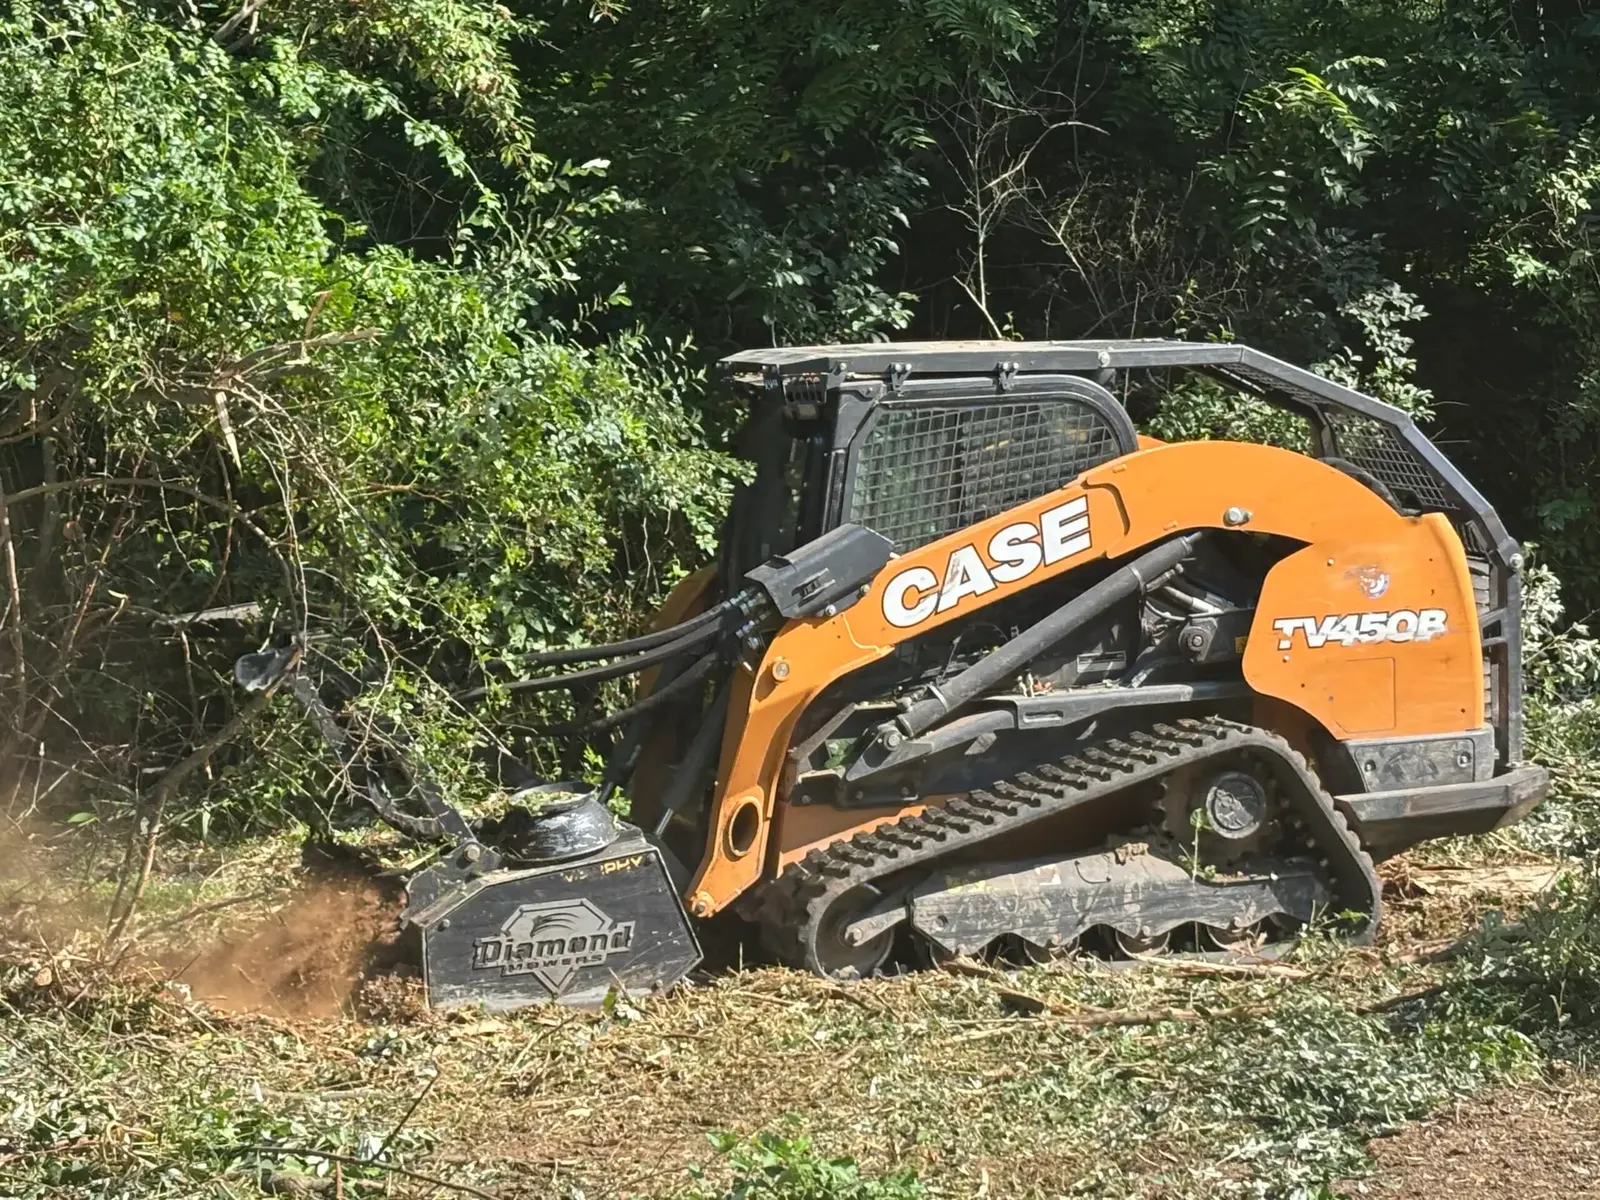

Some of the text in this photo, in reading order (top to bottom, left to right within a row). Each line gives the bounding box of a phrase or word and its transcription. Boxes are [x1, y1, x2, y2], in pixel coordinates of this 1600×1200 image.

[881, 495, 1092, 627] CASE
[476, 924, 633, 965] Diamond
[509, 954, 603, 973] MOWERS
